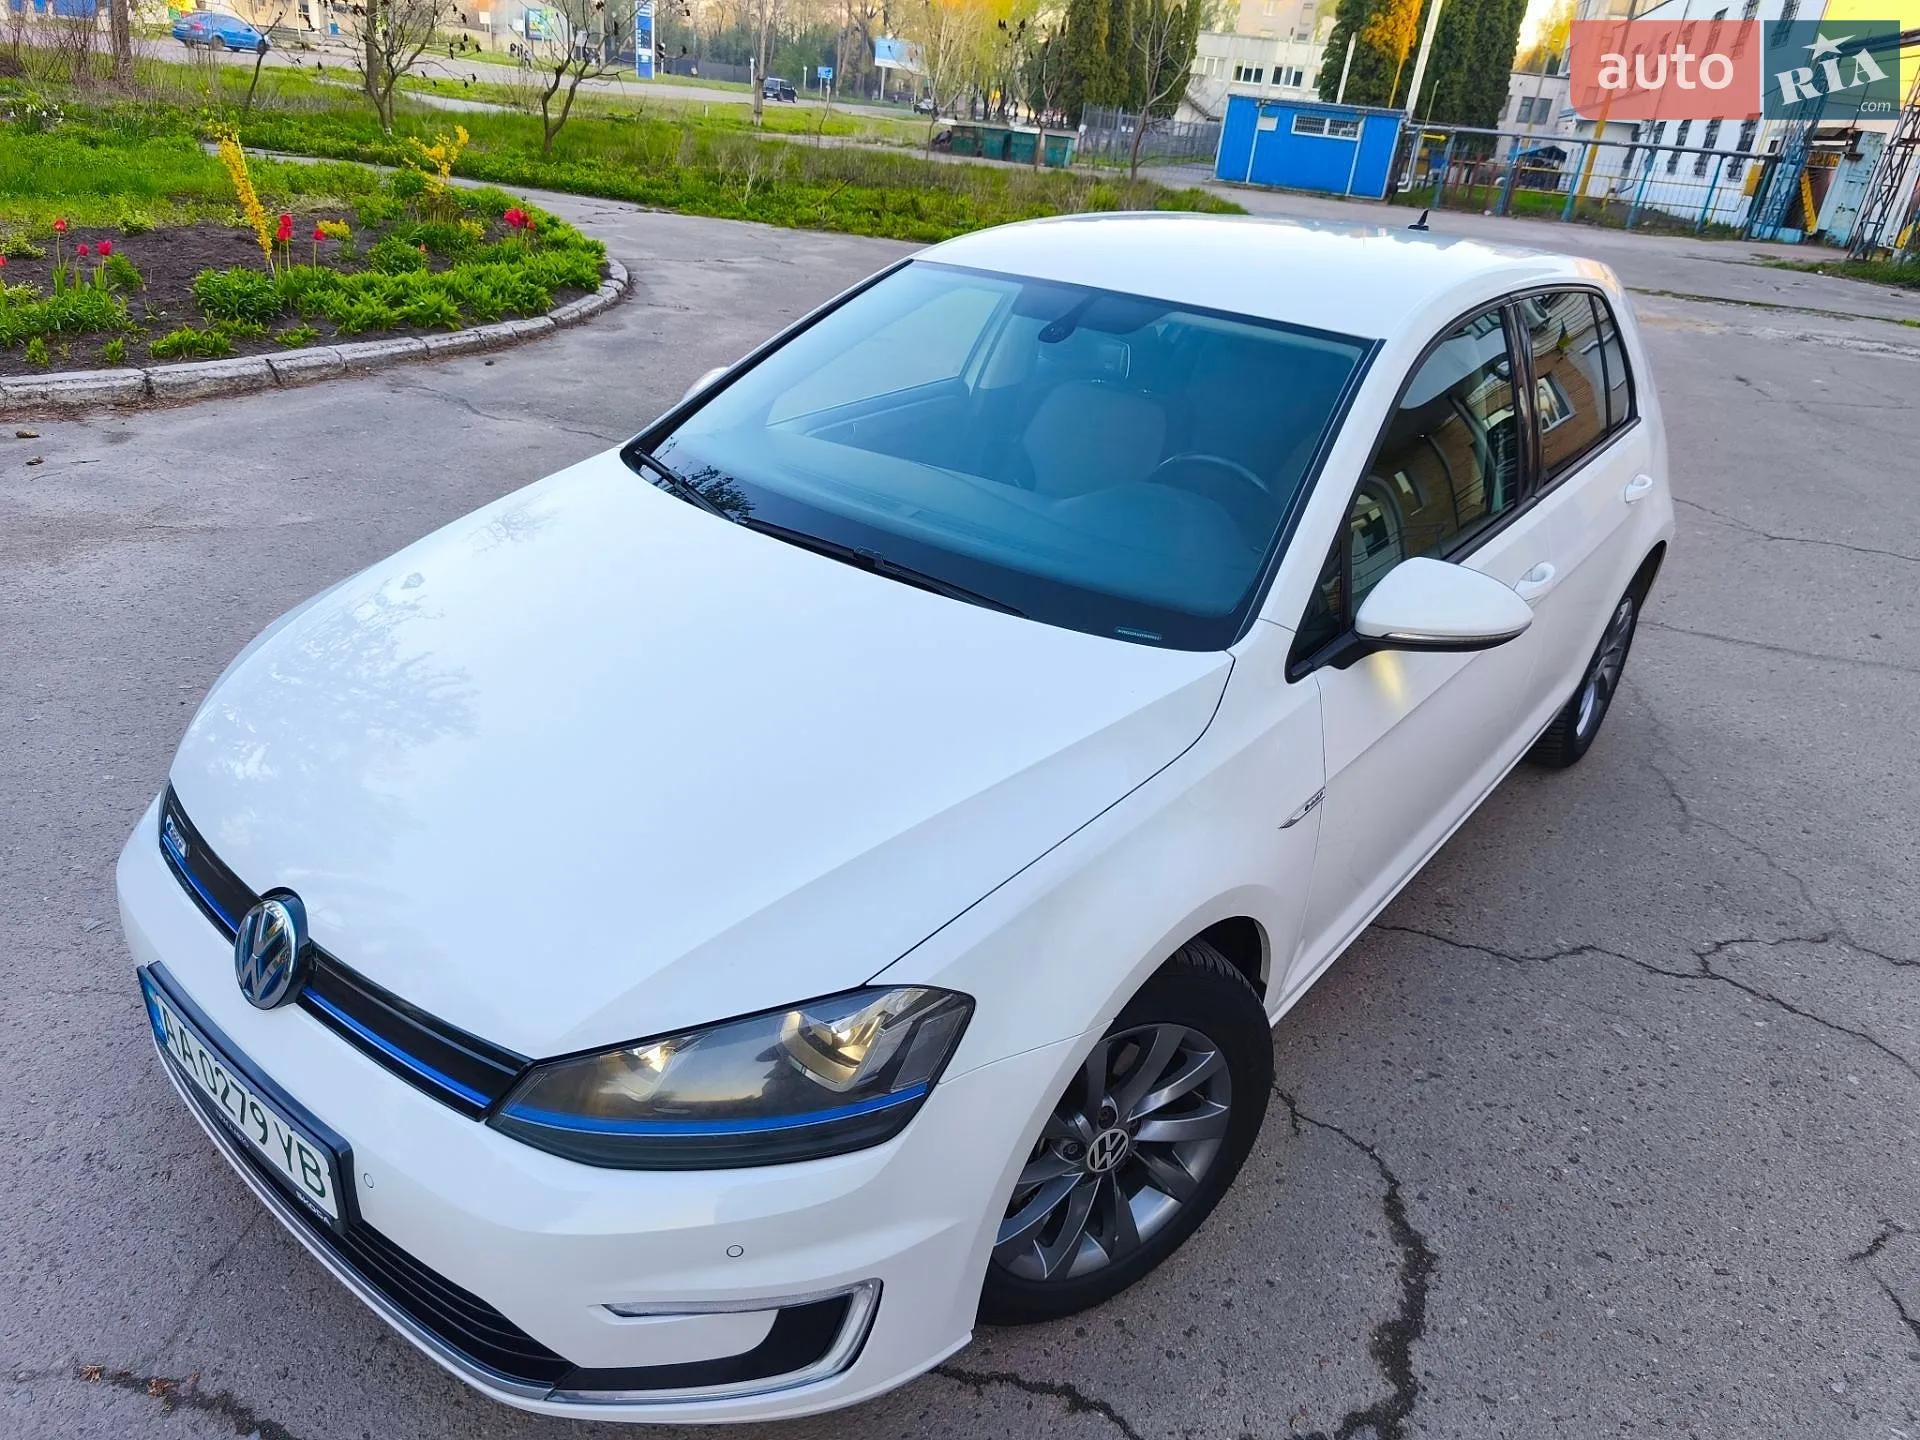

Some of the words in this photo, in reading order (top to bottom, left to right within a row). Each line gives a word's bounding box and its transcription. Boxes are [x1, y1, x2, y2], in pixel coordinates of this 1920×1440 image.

[162, 1006, 200, 1078] AA
[198, 1048, 269, 1146] 0279
[274, 1120, 326, 1198] YB
